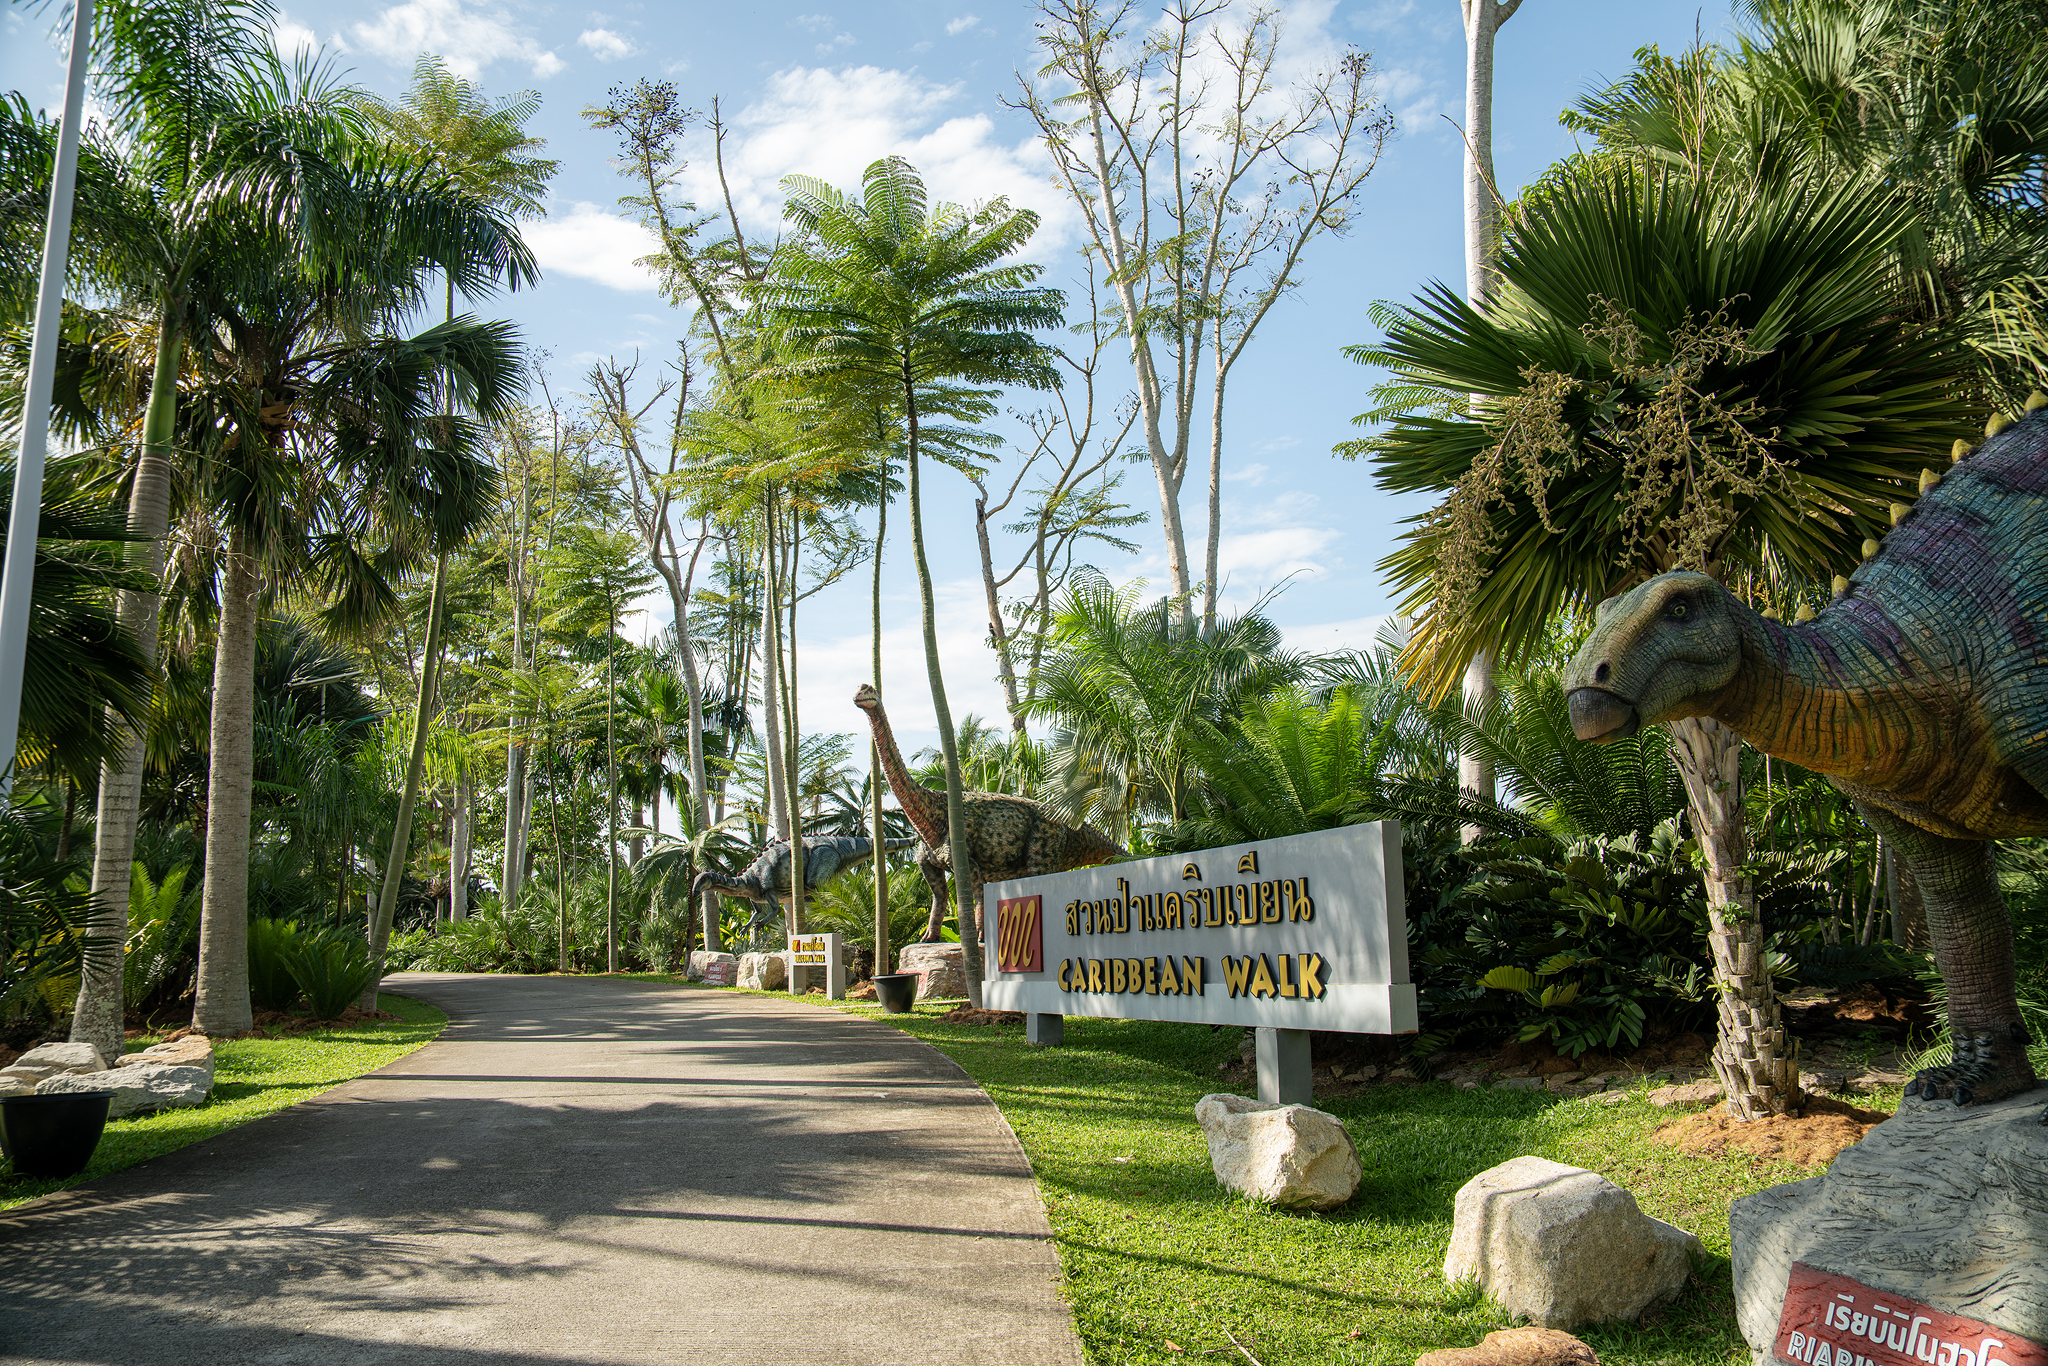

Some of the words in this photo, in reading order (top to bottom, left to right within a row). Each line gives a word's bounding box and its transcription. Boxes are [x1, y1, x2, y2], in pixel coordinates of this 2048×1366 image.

[1065, 850, 1315, 936] สวนป่าแคริบเบียน
[1057, 955, 1204, 997] CARIBBEAN
[1221, 953, 1326, 999] WALK
[1825, 1293, 2010, 1366] เรียบินิโนฮาโ
